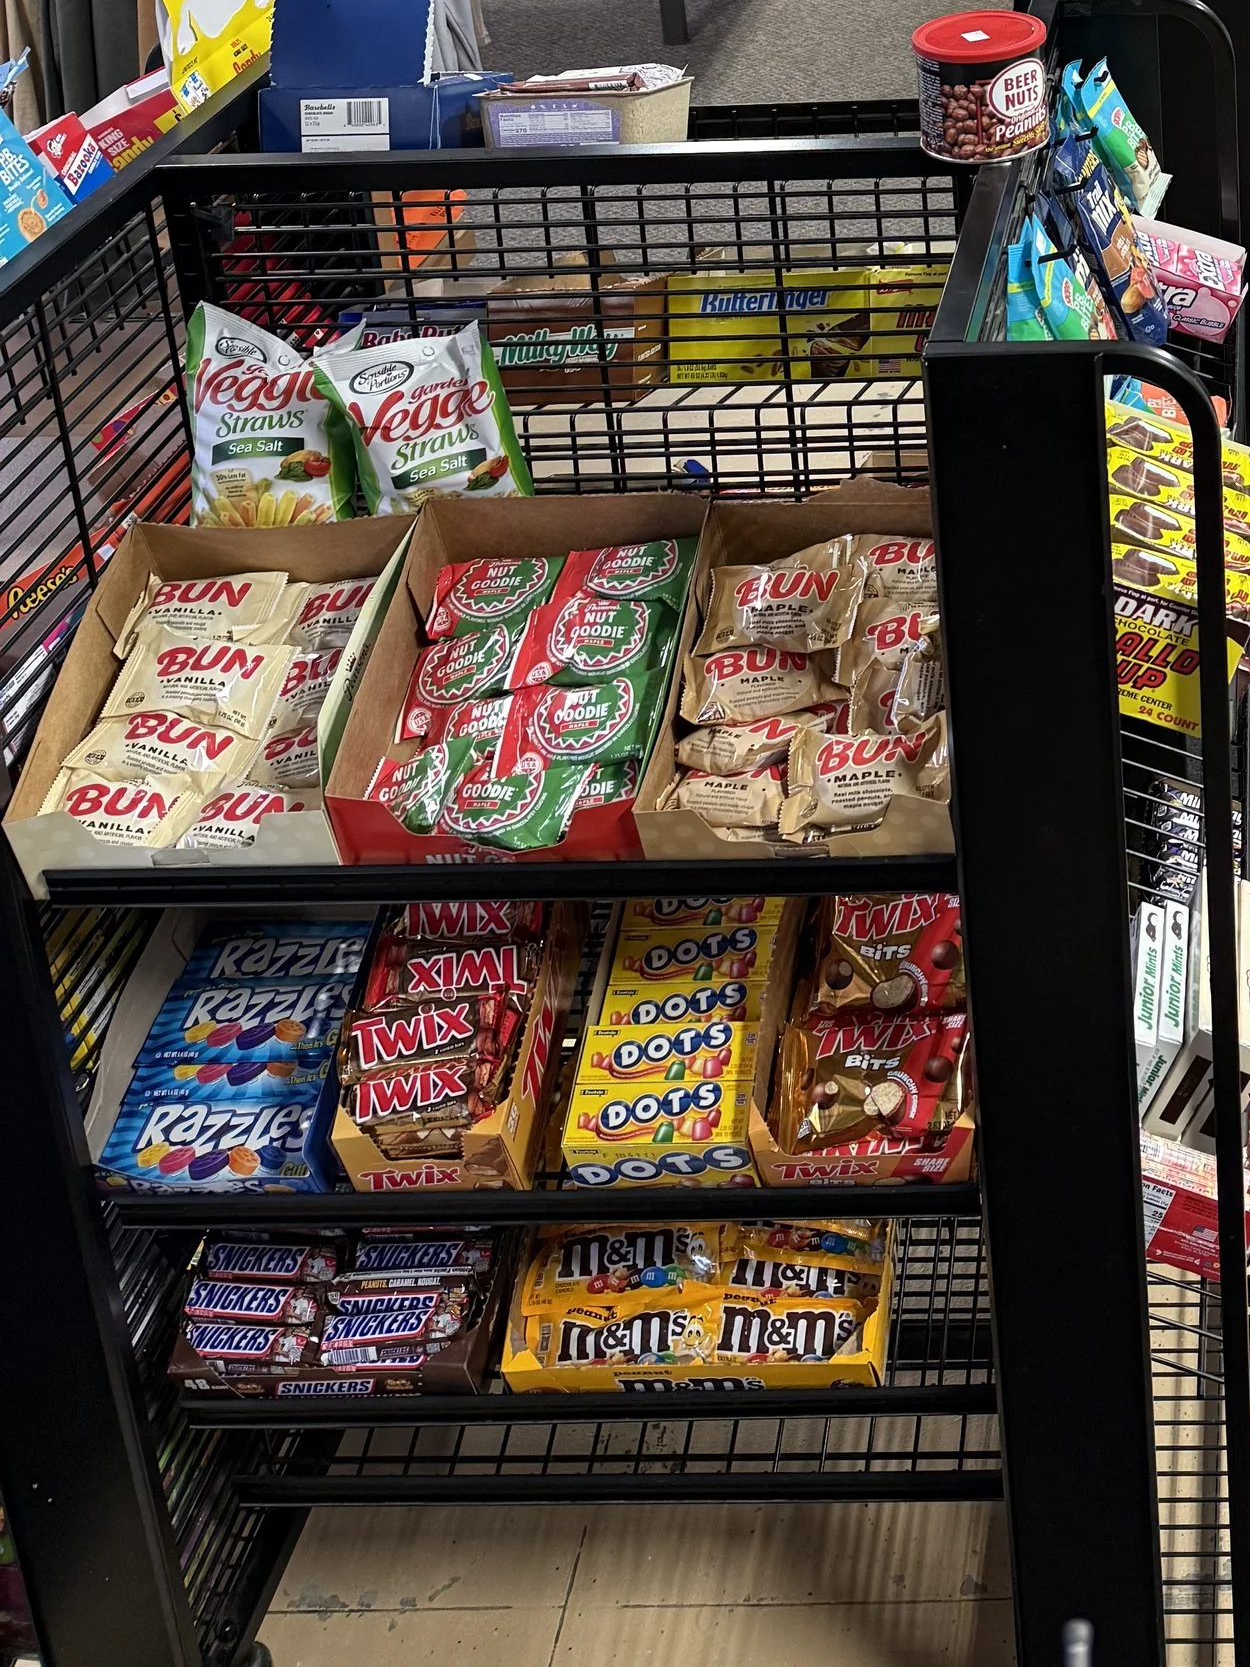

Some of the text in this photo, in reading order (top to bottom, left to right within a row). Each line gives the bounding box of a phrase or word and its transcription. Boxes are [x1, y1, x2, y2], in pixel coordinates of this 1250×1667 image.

[1004, 69, 1038, 94] BEER
[1004, 85, 1039, 111] NUTS
[995, 103, 1048, 143] Peanuts
[1011, 108, 1036, 125] Original
[99, 129, 124, 150] KING
[107, 138, 131, 157] SIZE
[66, 141, 99, 188] Bazooka
[369, 369, 409, 392] Portions
[215, 409, 306, 438] Straws
[228, 439, 283, 455] Sea Salt
[390, 422, 480, 471] Straws
[408, 455, 468, 483] Sea Salt
[617, 546, 644, 559] NUT
[471, 575, 522, 590] GOODIE
[487, 565, 515, 578] NUT
[153, 581, 253, 608] BUN
[735, 569, 840, 606] BUN
[155, 607, 219, 617] VANILLA
[584, 610, 618, 624] NUT
[1114, 595, 1199, 637] DARK
[571, 625, 626, 640] GOODIE
[156, 644, 265, 680] BUN
[449, 640, 477, 660] NUT
[436, 652, 485, 678] GOODIE
[704, 647, 808, 684] BUN
[165, 676, 226, 688] VANILLA
[739, 673, 785, 685] MAPLE
[553, 702, 608, 723] GOODIE
[1140, 695, 1173, 712] CENTER
[1137, 705, 1199, 732] 24 COUNT
[124, 712, 234, 761] BUN
[130, 742, 189, 767] VANILLA
[818, 734, 927, 778] BUN
[462, 783, 516, 799] GOODIE
[704, 780, 749, 792] MAPLE
[833, 770, 896, 785] MAPLE
[66, 782, 181, 821] BUN
[196, 824, 256, 843] VANILLA
[644, 928, 757, 971] DOTS
[1139, 945, 1159, 1030] Junior Mints
[1165, 944, 1185, 1028] Junior Mints
[635, 984, 744, 1025] DOTS
[618, 1024, 730, 1068] DOTS
[606, 1085, 720, 1129] DOTS
[574, 1148, 744, 1186] DOTS
[209, 1245, 305, 1274] SNICKERS
[360, 1243, 459, 1267] SNICKERS
[557, 1227, 692, 1280] m&m's
[187, 1283, 289, 1315] SNICKERS
[328, 1309, 428, 1339] SNICKERS
[557, 1309, 689, 1363] m&m's
[717, 1304, 854, 1357] m&m's
[280, 1380, 371, 1395] SNICKERS
